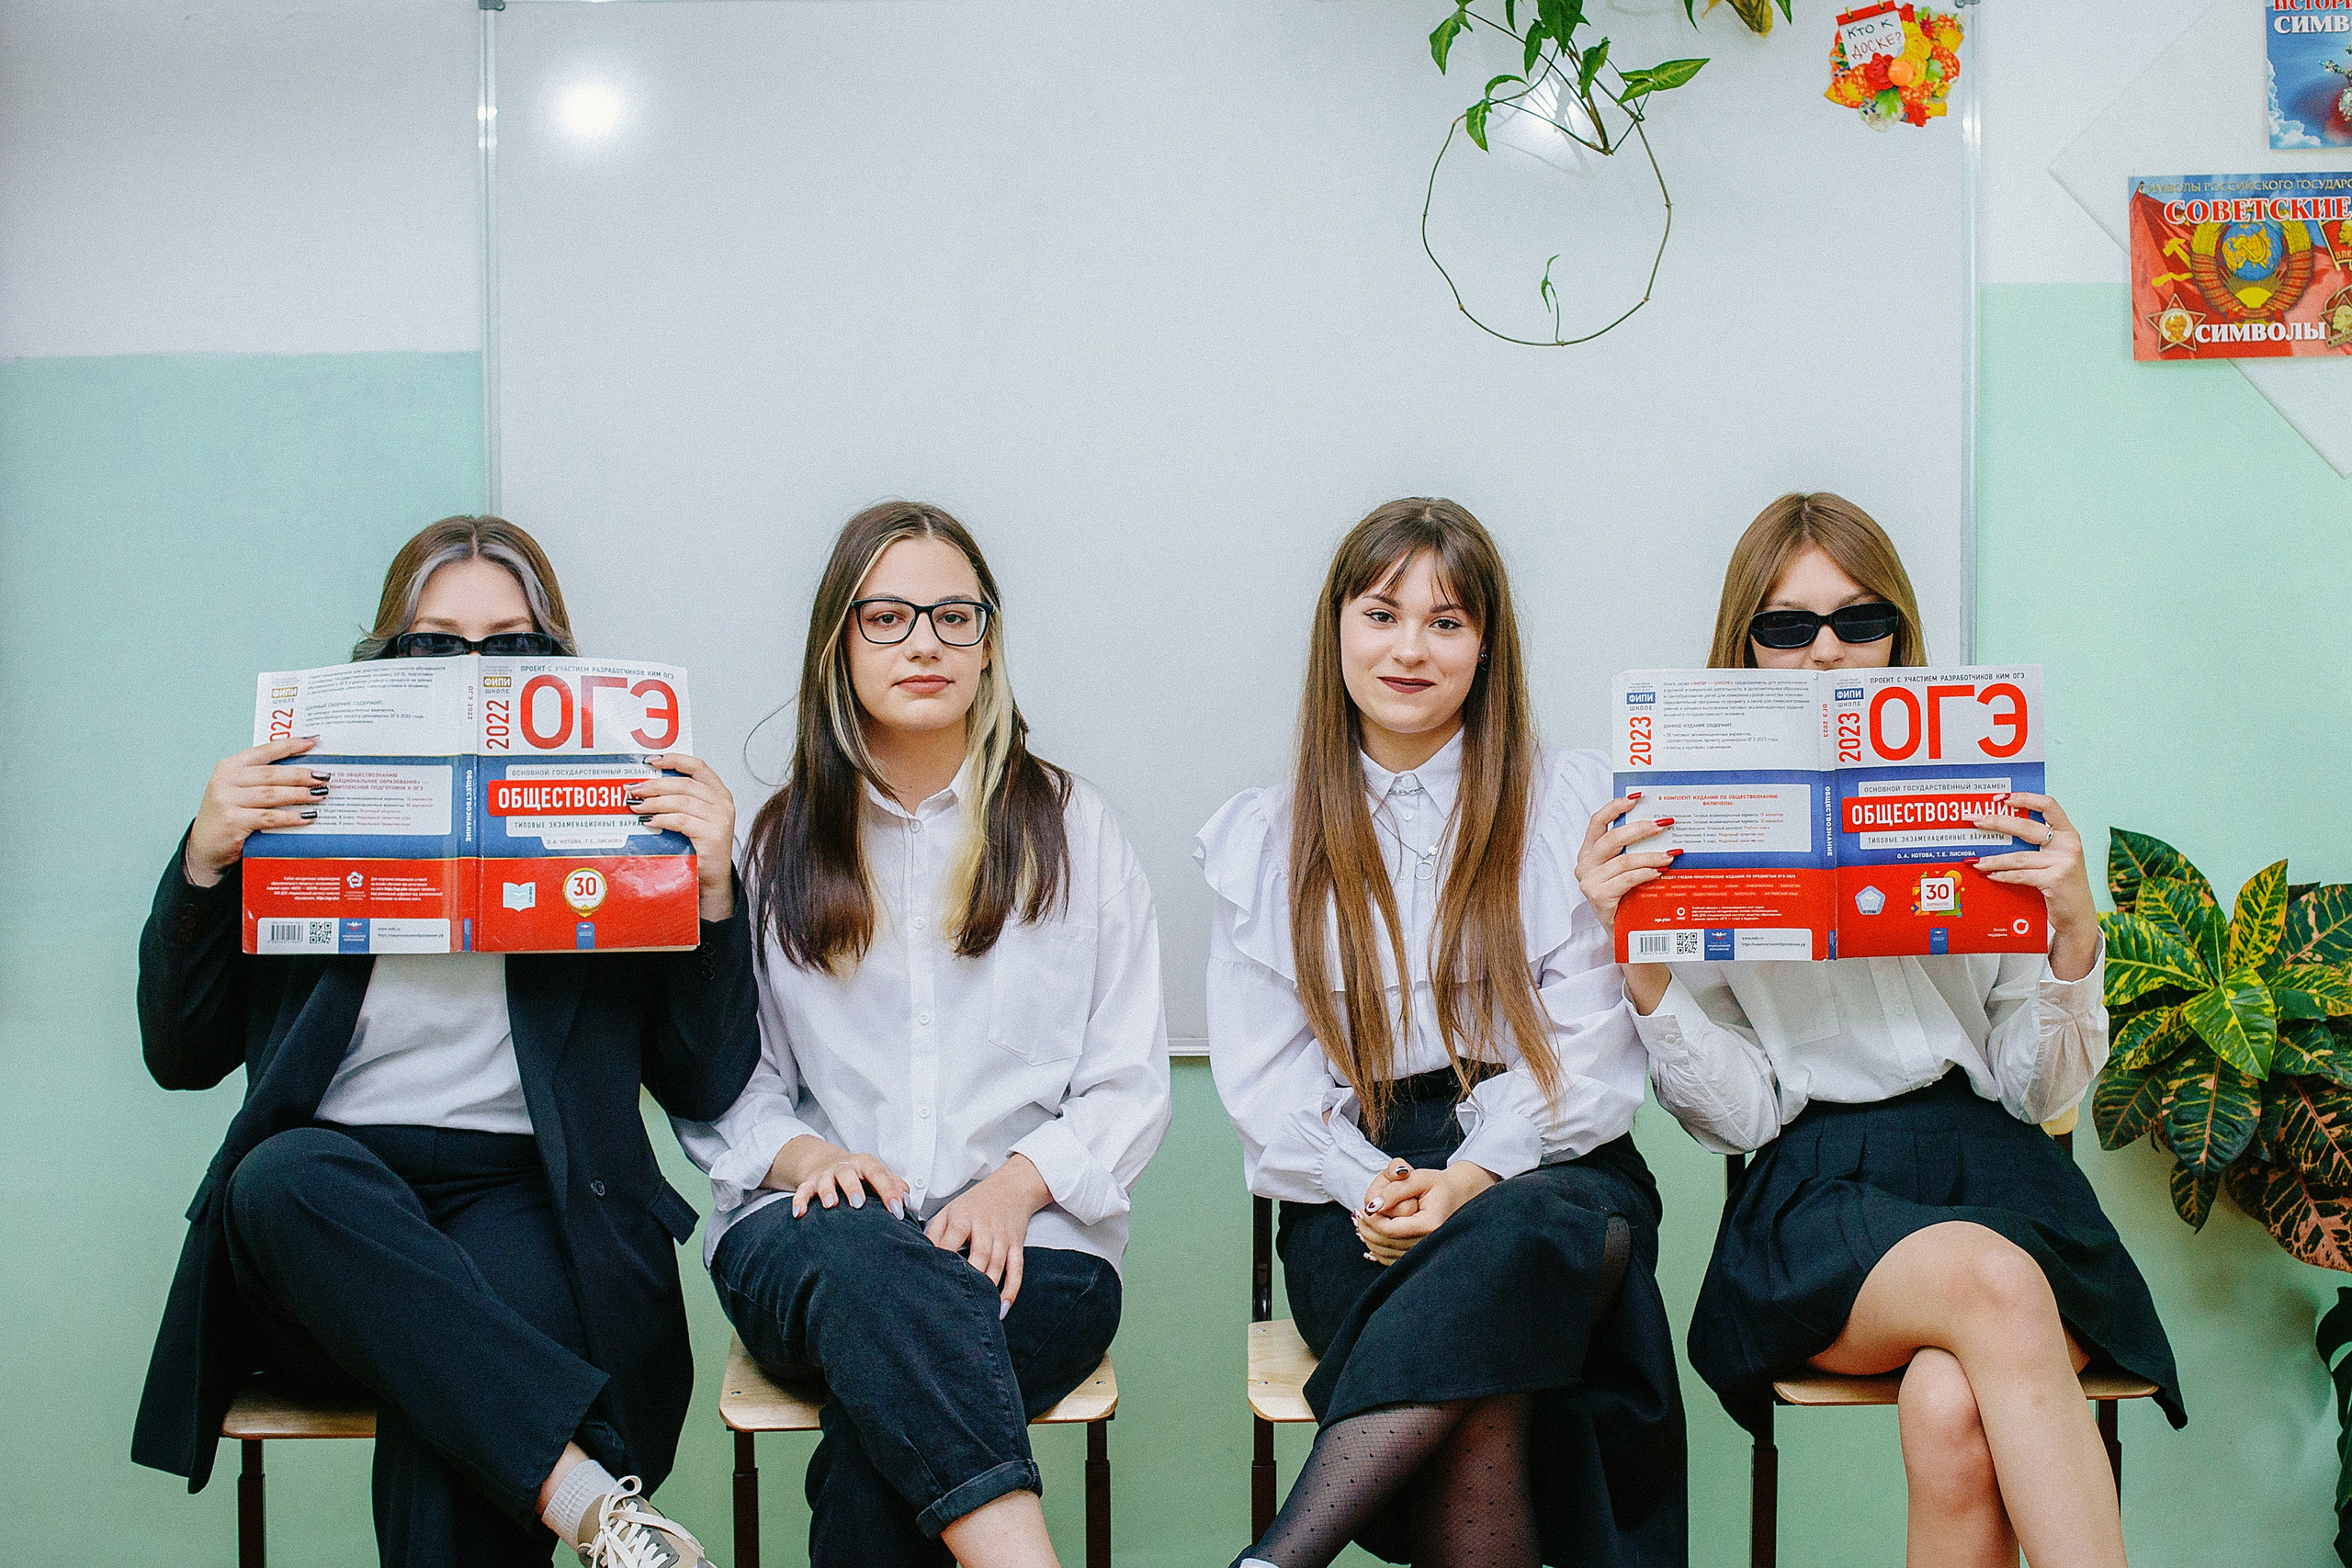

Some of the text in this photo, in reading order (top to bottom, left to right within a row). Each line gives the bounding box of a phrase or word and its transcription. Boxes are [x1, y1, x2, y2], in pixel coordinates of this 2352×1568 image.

[2273, 0, 2352, 11] ИСТОР
[1847, 18, 1894, 39] КТО К
[2273, 15, 2352, 34] СИМВ
[1851, 31, 1902, 61] ДОСКЕ?
[2138, 182, 2201, 194] СИМВОЛЫ
[2203, 179, 2293, 192] РОССИЙСКОГО
[2164, 196, 2352, 224] СОВЕТСКИЕ
[2194, 321, 2327, 344] СИМВОЛЫ
[593, 666, 645, 676] РАЗРАБОТЧИКОВ
[663, 671, 675, 680] ОГЭ
[1904, 674, 1938, 682] УЧАСТИЕМ
[1940, 672, 1993, 682] РАЗРАБОТЧИКОВ
[2012, 671, 2026, 680] ОГЭ
[484, 677, 511, 687] ФИПИ
[272, 688, 297, 697] ФИПИ
[1629, 694, 1654, 703] ФИПИ
[1836, 690, 1861, 700] ФИПИ
[520, 674, 679, 750] ОГЭ
[270, 708, 294, 742] 022
[486, 700, 509, 750] 2022
[1869, 682, 2029, 761] ОГЭ
[1630, 716, 1652, 766] 2023
[1838, 712, 1861, 762] 2023
[552, 768, 621, 776] ГОСУДАРСТВЕННЫЙ
[1904, 784, 1971, 792] ГОСУДАРСТВЕННЫЙ
[549, 820, 616, 829] ЭКЗАМЕНАЦИОННЫЕ
[1825, 785, 1833, 857] ОБЩЕСТВОЗНАНИЕ
[1902, 834, 1966, 842] ЭКЗАМЕНАЦИОННЫЕ
[574, 876, 597, 897] 30
[1926, 884, 1950, 900] 30
